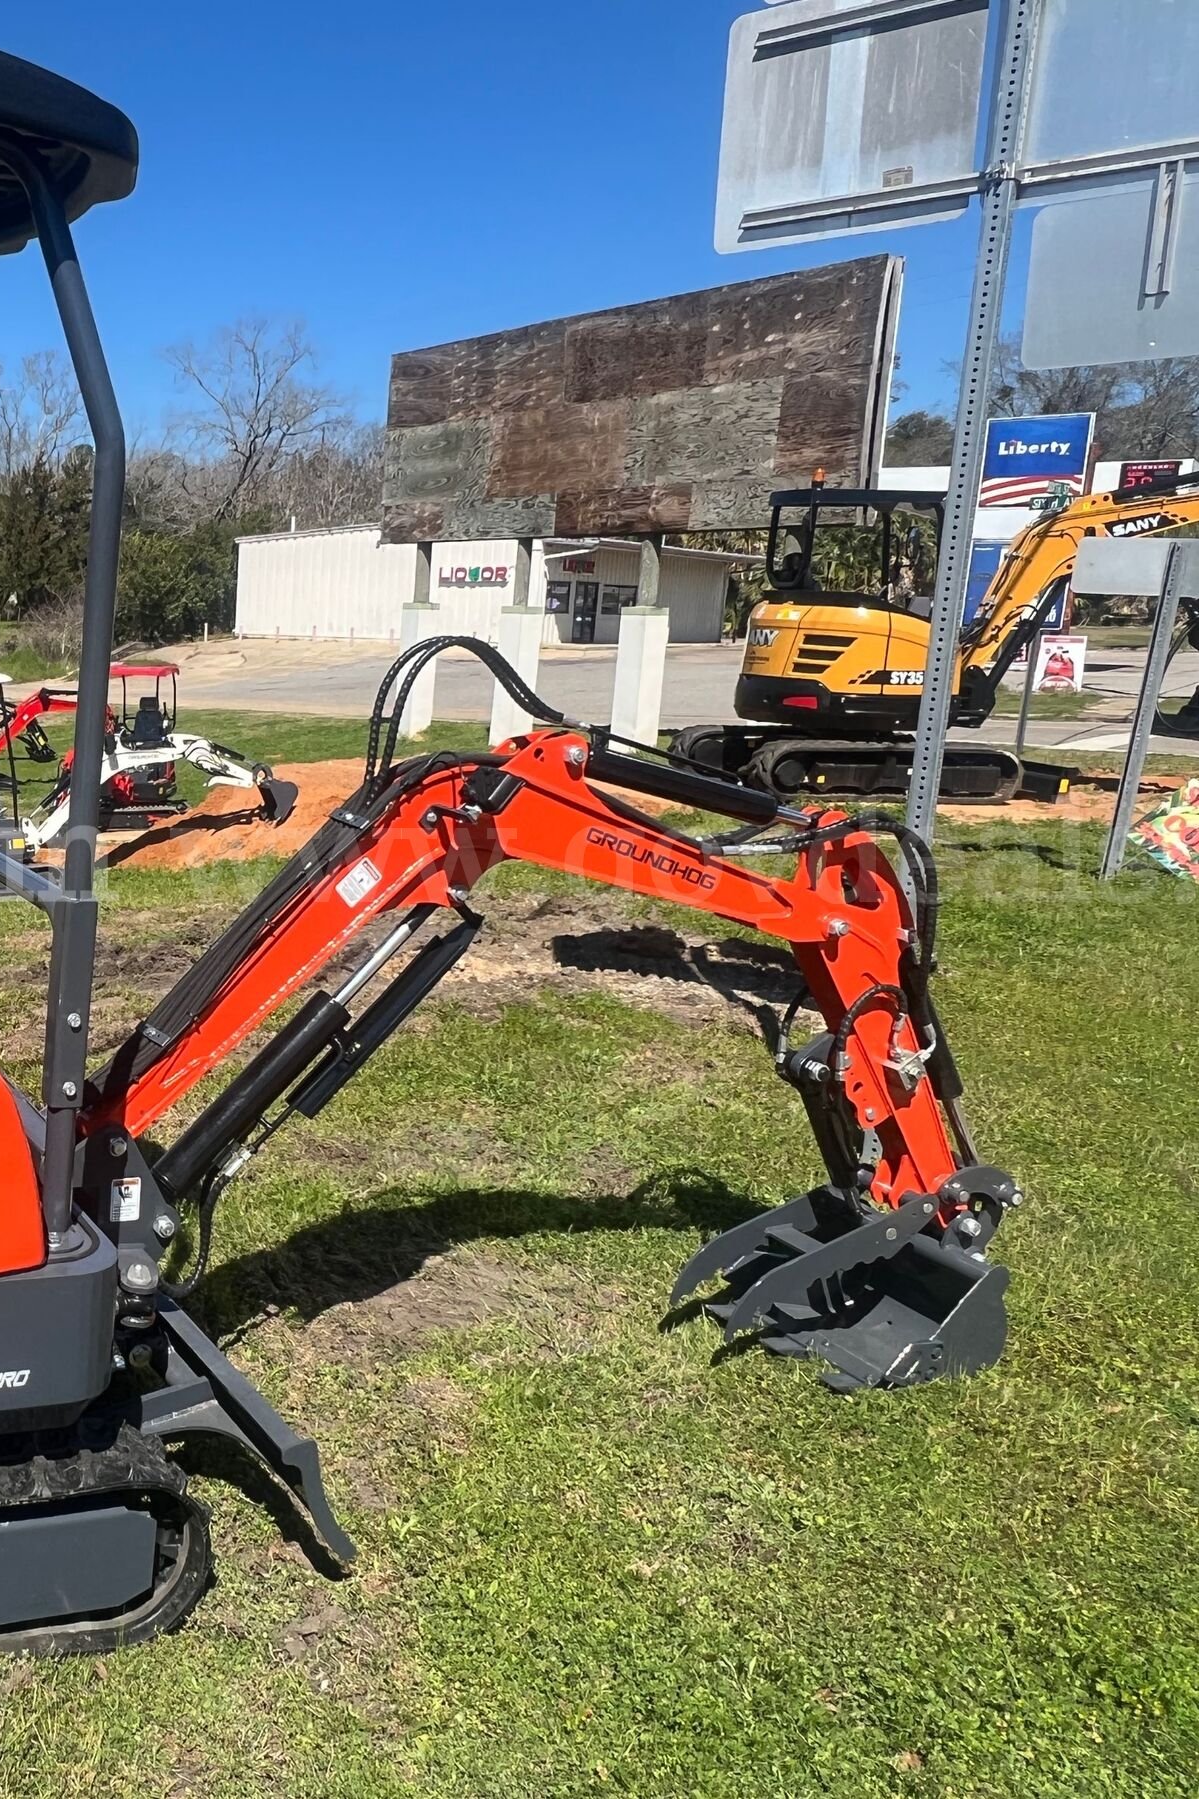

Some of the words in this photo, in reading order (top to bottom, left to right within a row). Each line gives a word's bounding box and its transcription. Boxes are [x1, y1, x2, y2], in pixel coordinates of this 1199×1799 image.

[998, 440, 1071, 456] Liberty
[1112, 514, 1162, 537] SANY
[586, 827, 717, 890] GROUNDHOG
